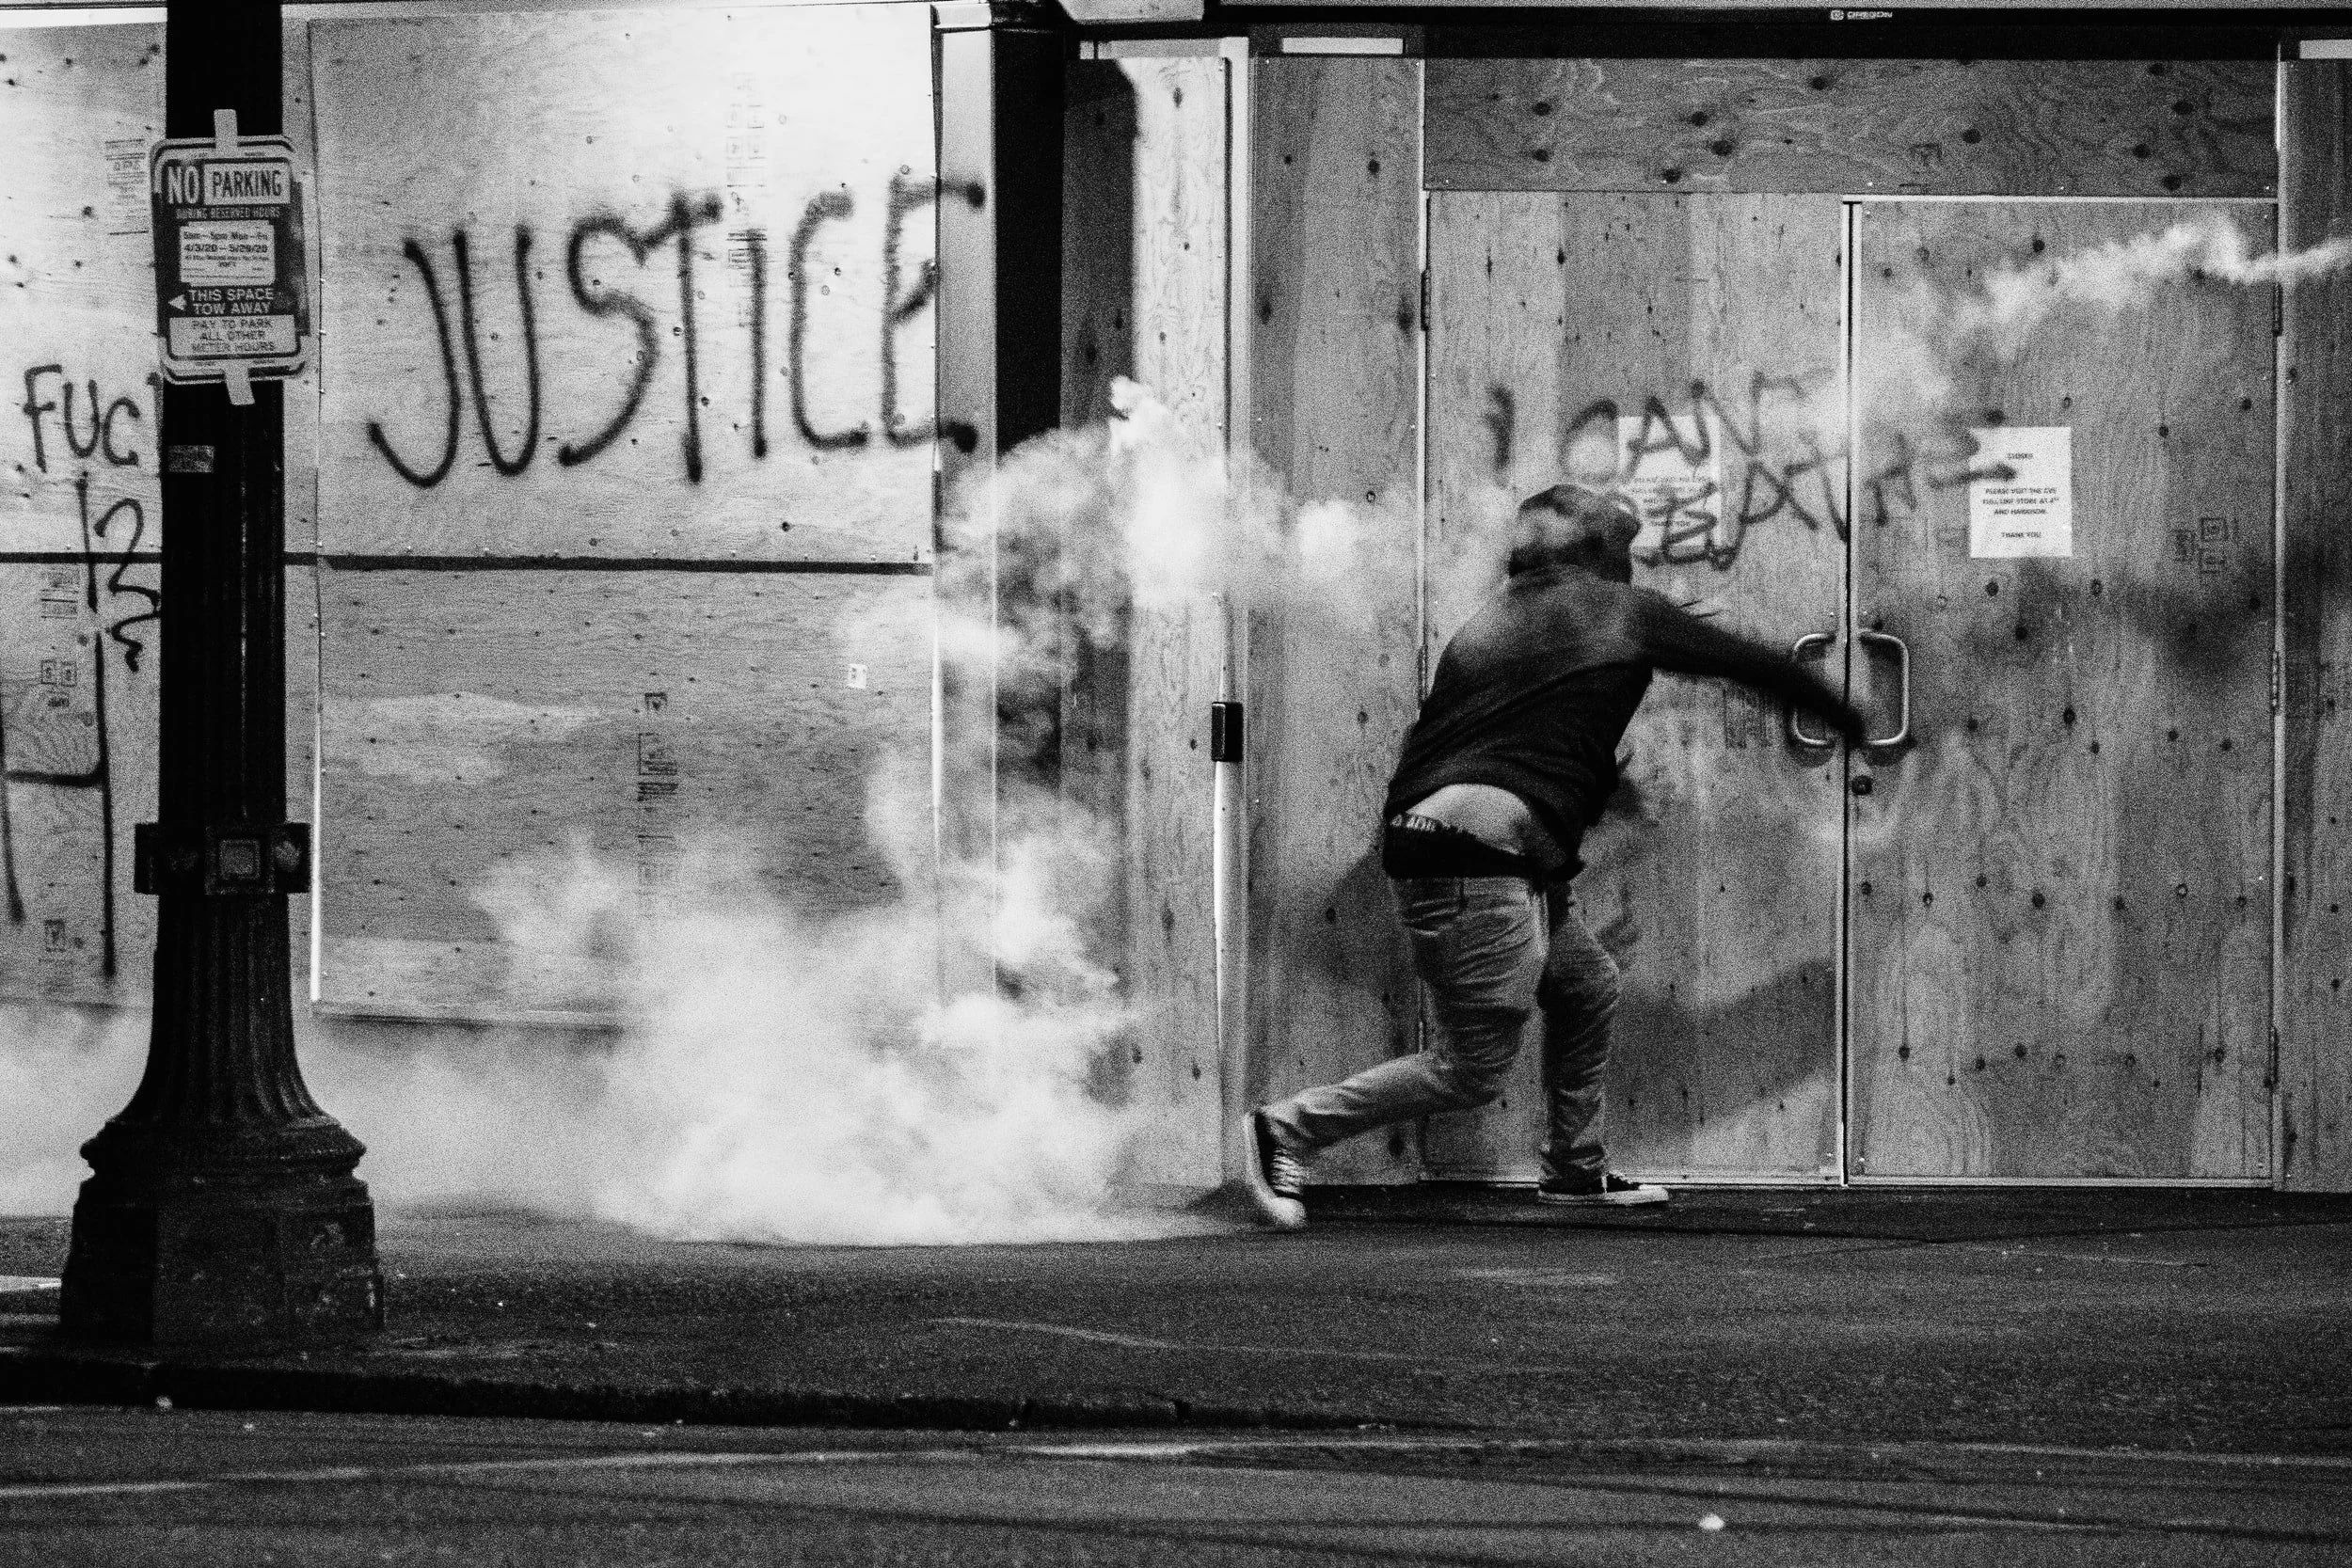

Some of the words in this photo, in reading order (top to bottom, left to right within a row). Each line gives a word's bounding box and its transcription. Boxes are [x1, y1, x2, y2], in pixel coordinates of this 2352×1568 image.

[167, 166, 199, 204] NO
[212, 169, 282, 198] PARKING
[211, 206, 250, 218] RESERVED
[253, 205, 280, 218] HOURS
[188, 289, 222, 302] THIS
[227, 288, 274, 301] SPACE
[193, 303, 226, 315] TOW
[230, 302, 271, 314] AWAY
[192, 320, 216, 330] PAY
[222, 319, 237, 329] TO
[241, 318, 273, 328] PARK
[371, 175, 978, 484] JUSTICE
[200, 331, 223, 341] ALL
[227, 330, 265, 341] OTHER
[235, 341, 276, 353] HOURS
